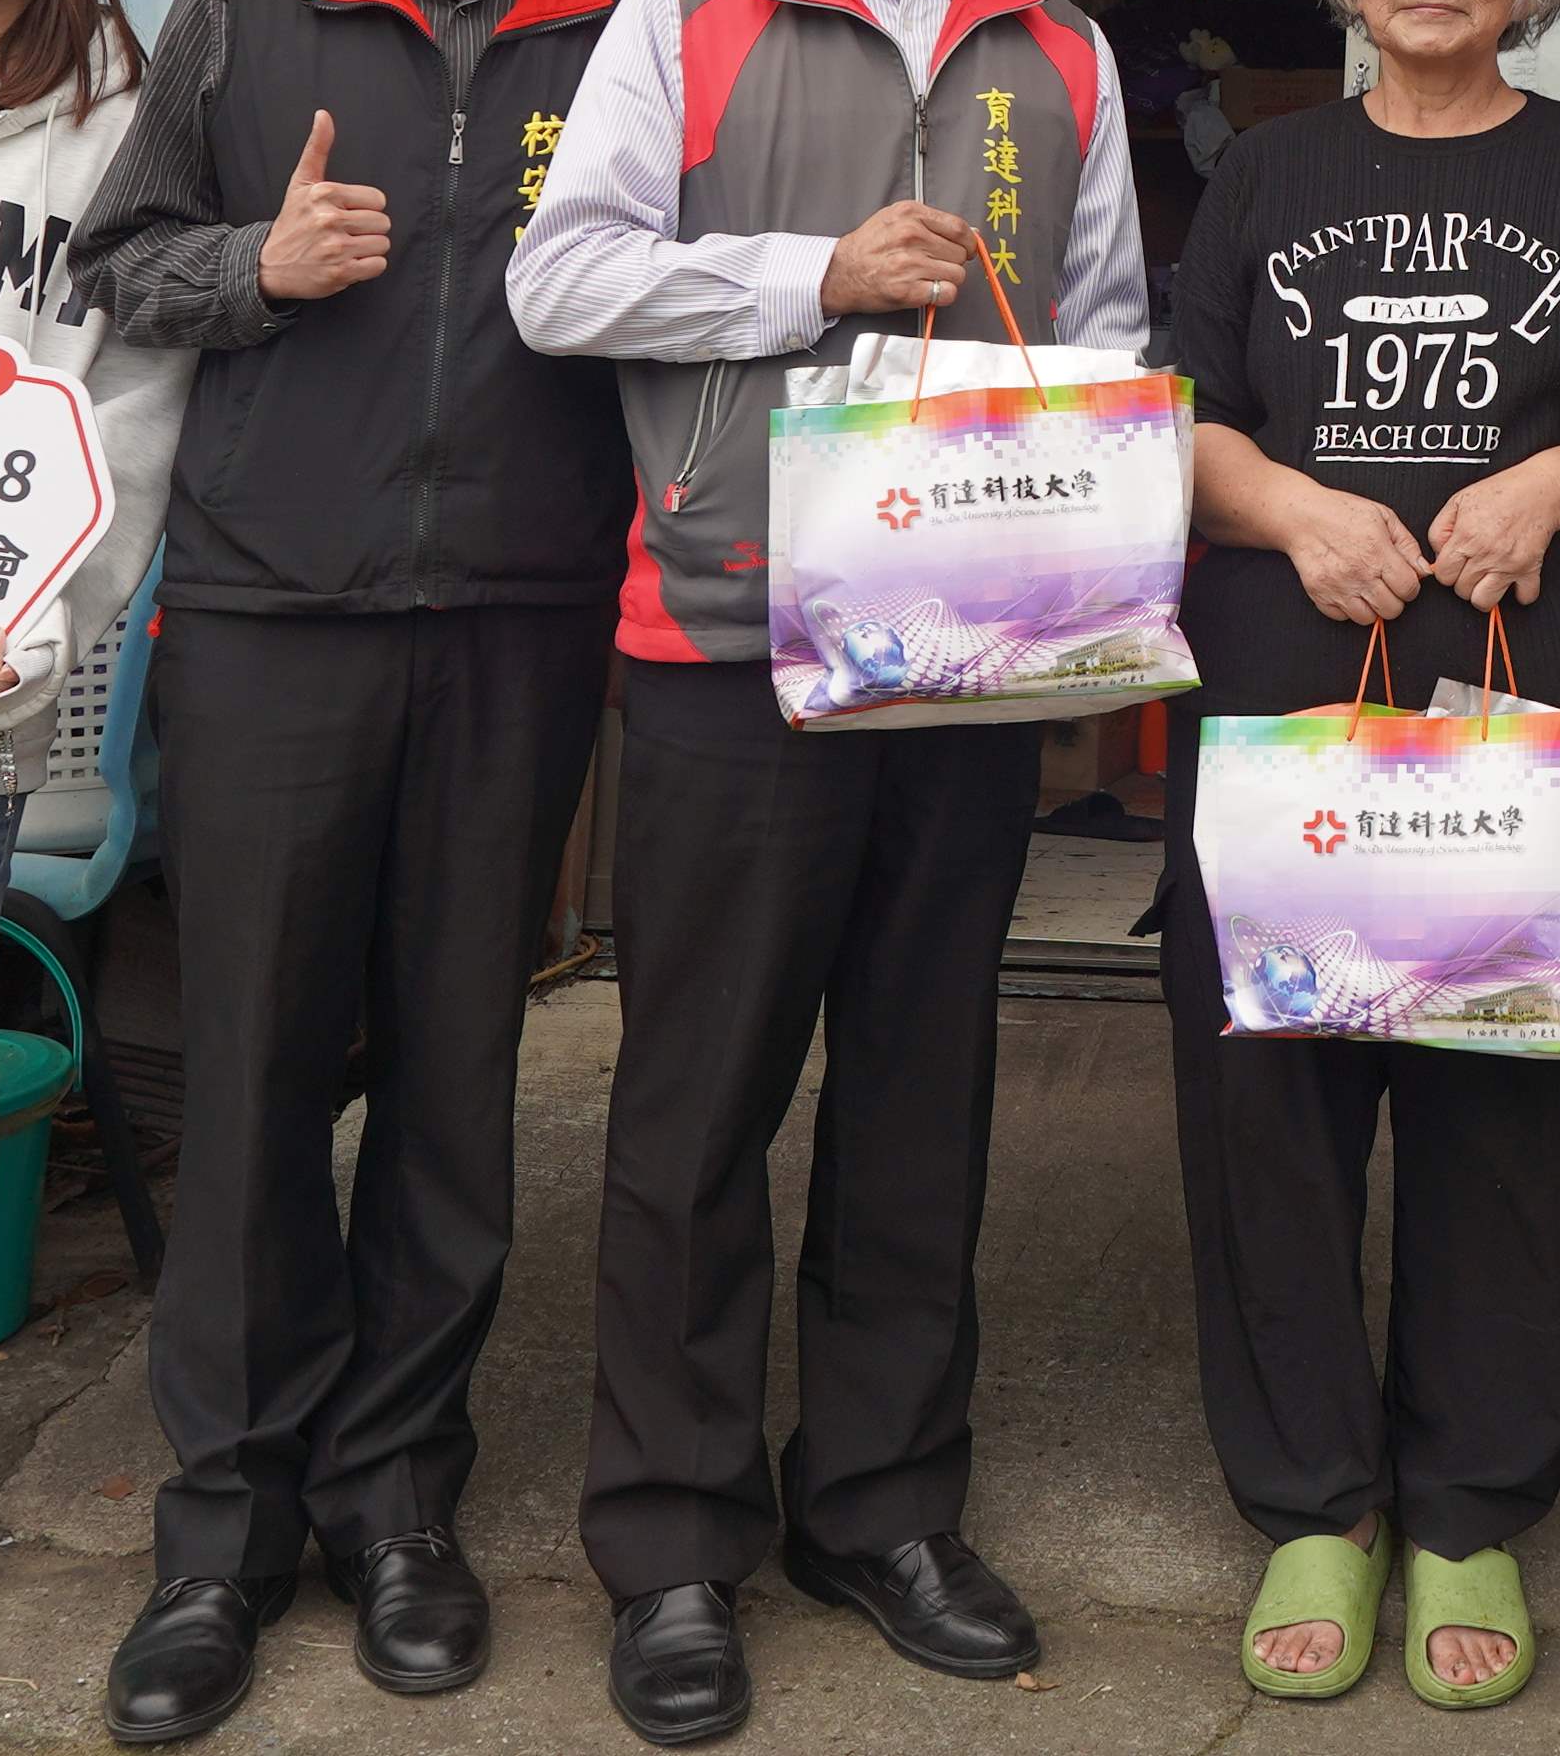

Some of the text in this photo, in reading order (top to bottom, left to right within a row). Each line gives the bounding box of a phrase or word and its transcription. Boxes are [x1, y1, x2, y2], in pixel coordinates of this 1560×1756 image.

[975, 87, 1023, 286] 育達科大
[1369, 299, 1467, 320] ITALIA
[1323, 332, 1500, 411] 1975
[1313, 424, 1502, 452] BEACH CLUB
[928, 468, 1097, 510] 育達科技大學
[1355, 805, 1524, 838] 育達科技大學
